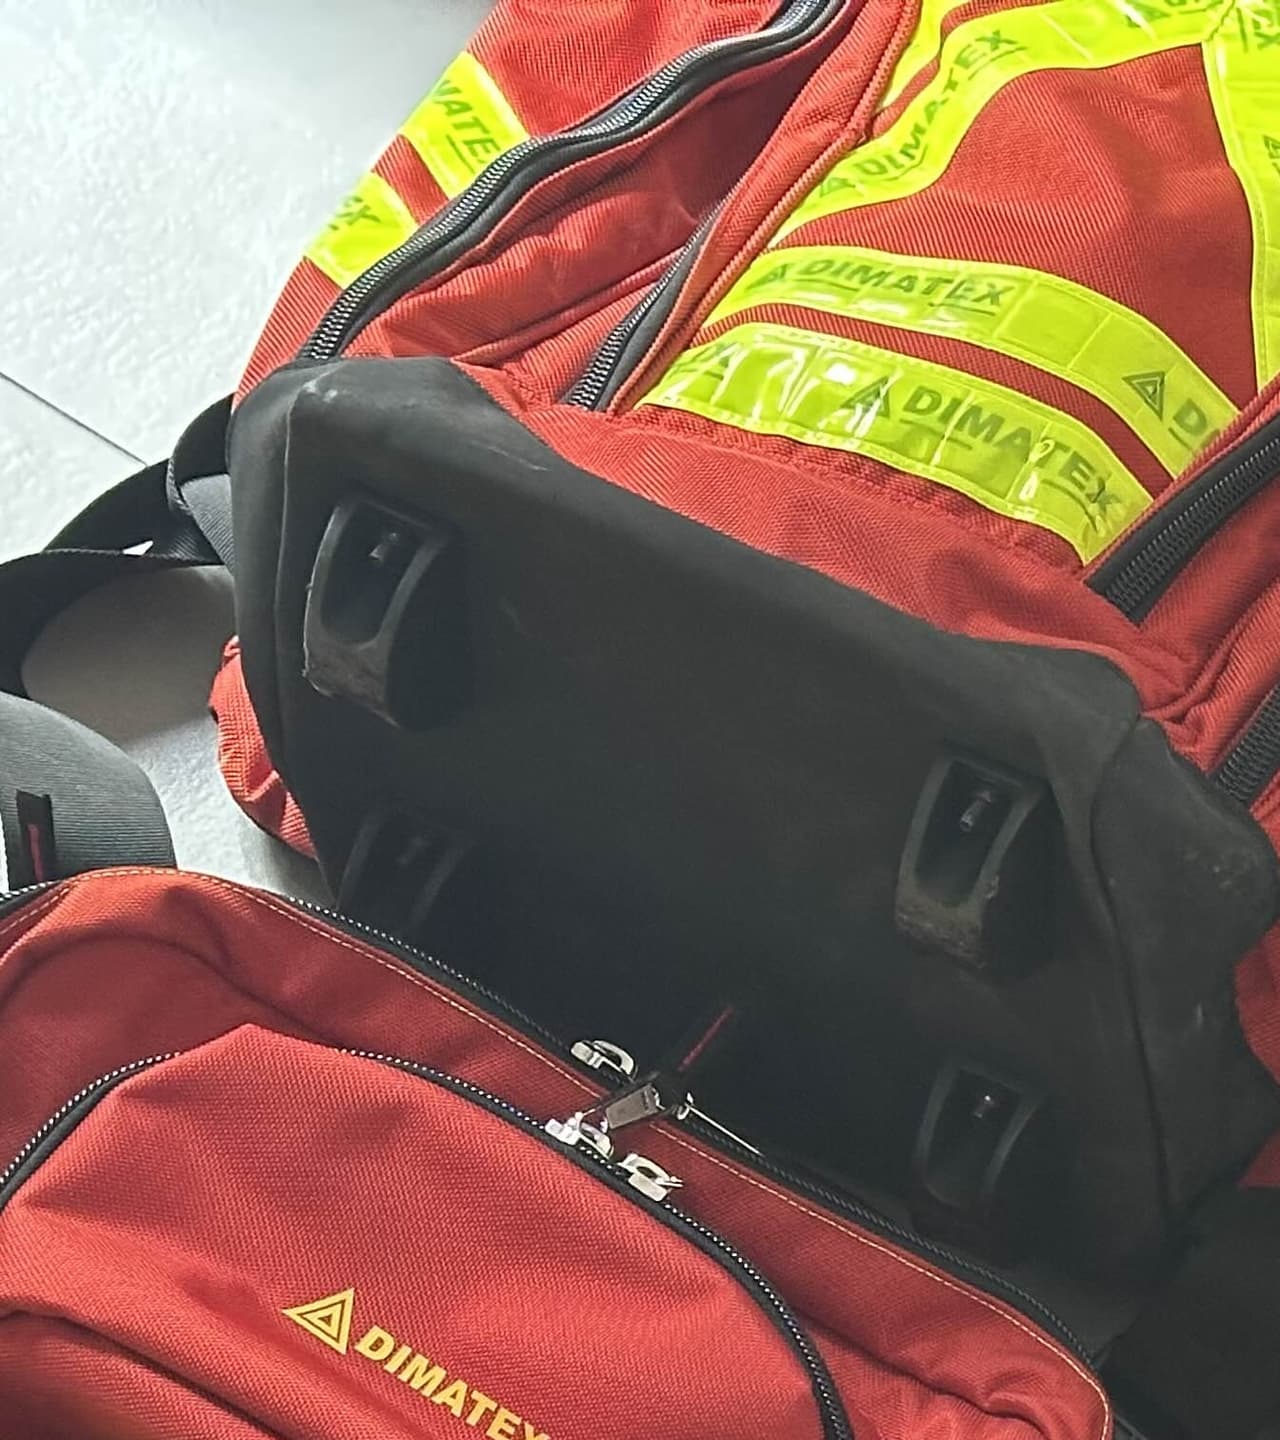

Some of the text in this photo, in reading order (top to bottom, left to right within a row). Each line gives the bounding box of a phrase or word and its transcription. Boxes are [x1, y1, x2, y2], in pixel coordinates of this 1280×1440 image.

[854, 30, 1018, 175] DIMATEX
[803, 259, 1014, 307] DIMATEX
[903, 386, 1121, 517] DIMATEX
